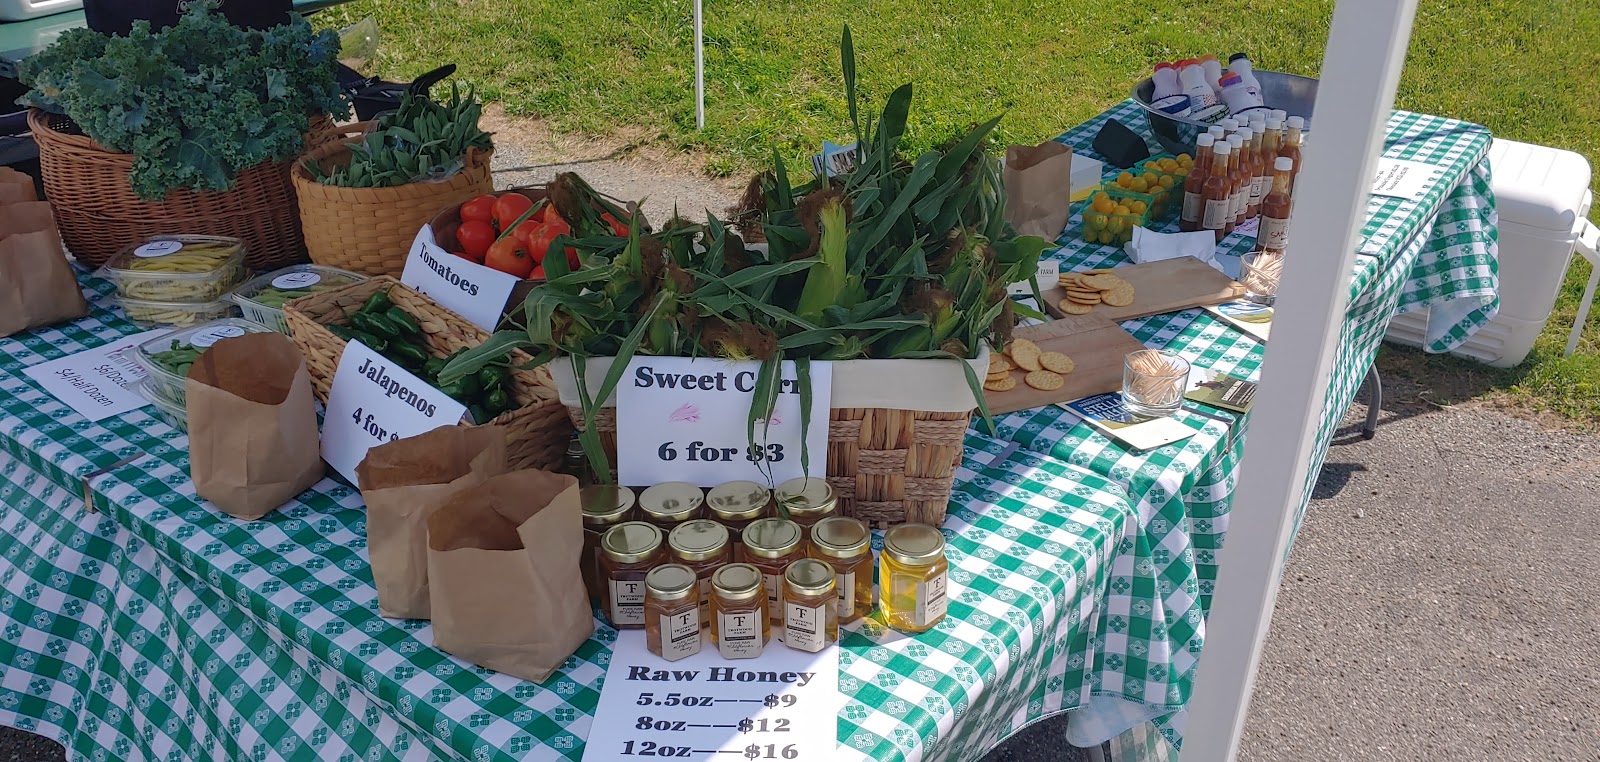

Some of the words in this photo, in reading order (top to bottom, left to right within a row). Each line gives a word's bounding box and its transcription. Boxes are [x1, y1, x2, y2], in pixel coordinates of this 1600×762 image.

[419, 242, 479, 296] Tomatoes
[358, 358, 437, 418] Jalapenos
[634, 366, 727, 392] Sweet
[84, 387, 114, 407] Dozen
[1083, 398, 1122, 415] STELLA
[352, 407, 363, 425] 4
[363, 414, 387, 442] for
[658, 441, 678, 462] 6
[686, 441, 738, 462] for
[746, 442, 785, 465] $3
[625, 665, 700, 682] Raw
[706, 666, 816, 687] Honey
